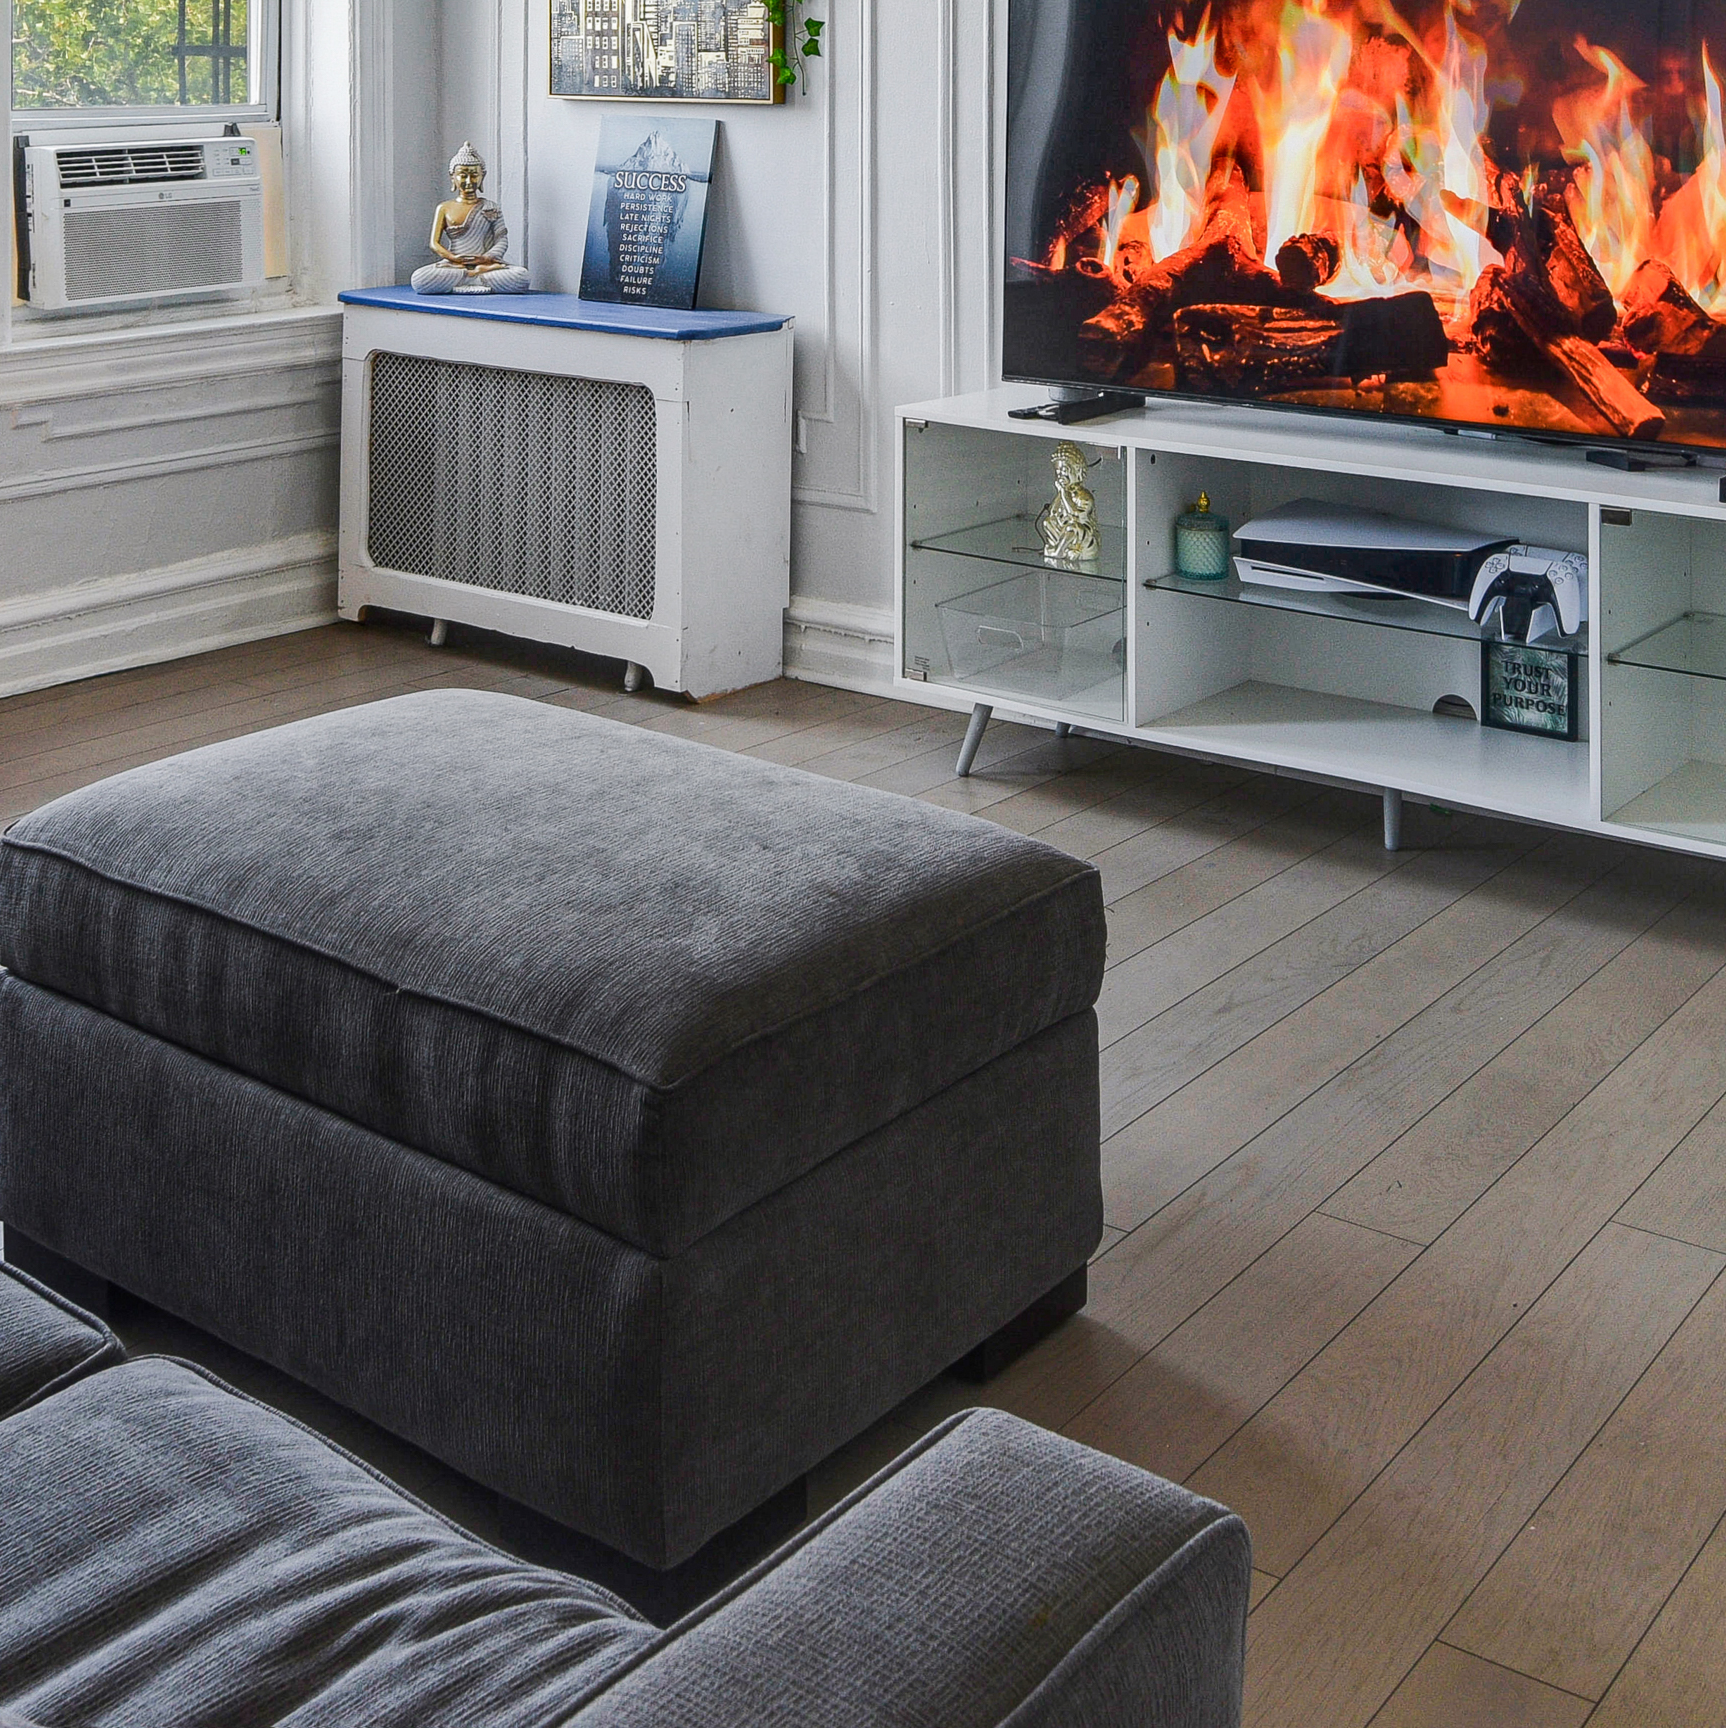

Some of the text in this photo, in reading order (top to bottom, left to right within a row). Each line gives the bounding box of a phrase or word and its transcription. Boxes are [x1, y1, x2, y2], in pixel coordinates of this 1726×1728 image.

[614, 171, 687, 192] SUCCESS
[623, 193, 673, 202] HARD WORK
[620, 202, 674, 214] PERSISTENCE
[619, 213, 671, 224] LATE NIGHTS
[620, 223, 669, 234] REJECTIONS
[622, 233, 664, 244] SACRIFICE
[619, 244, 664, 254] DISCIPLINE
[619, 254, 660, 264] CRITICISM
[621, 265, 655, 275] DOUBTS
[620, 275, 653, 285] FAILURE
[623, 286, 647, 295] RISKS
[1501, 660, 1554, 680] TRUST
[1500, 676, 1552, 697] YOUR
[1492, 692, 1566, 716] PURPOSE
